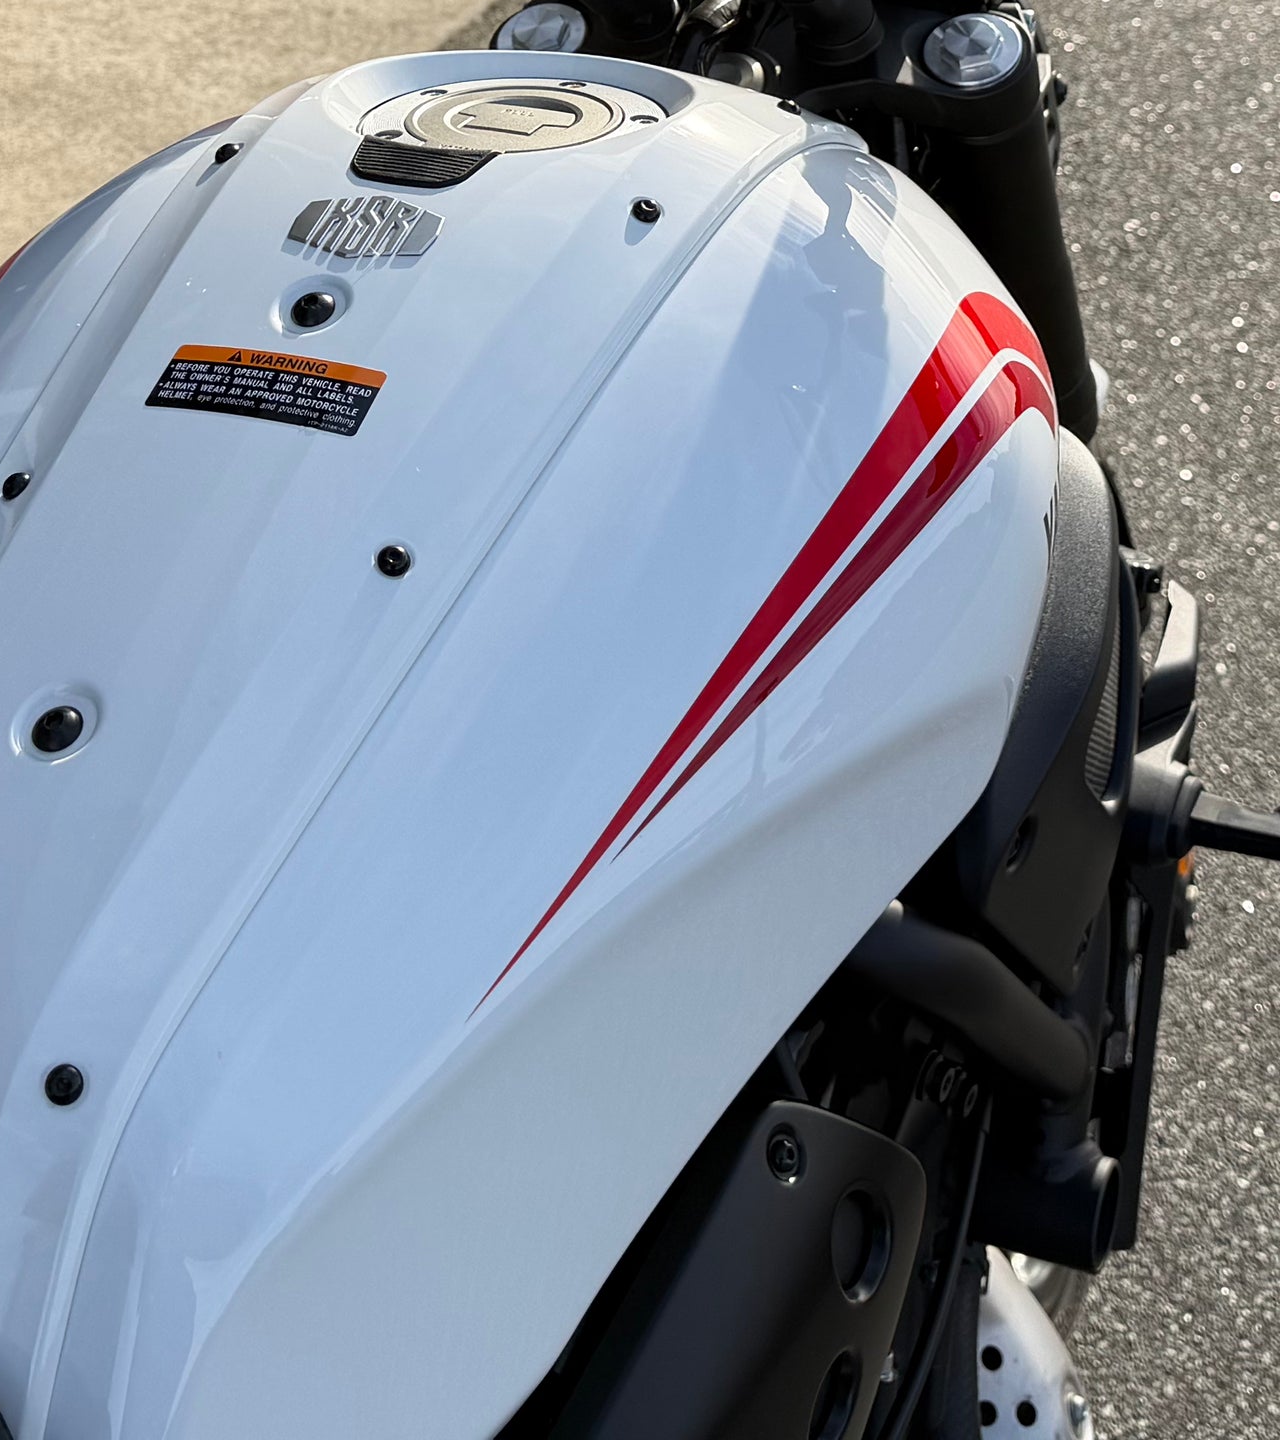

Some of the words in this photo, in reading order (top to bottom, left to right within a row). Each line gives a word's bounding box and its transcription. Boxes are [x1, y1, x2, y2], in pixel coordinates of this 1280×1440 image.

[310, 195, 421, 258] XSR
[175, 362, 210, 373] BEFORE
[213, 365, 230, 375] YOU
[234, 367, 274, 380] OPERATE
[278, 373, 298, 384] THIS
[346, 384, 372, 398] READ
[249, 352, 329, 375] WARNING
[163, 380, 197, 392] ALWAYS
[200, 383, 226, 395] WEAR
[229, 386, 241, 396] AN
[244, 389, 293, 404] APPROVED
[296, 397, 359, 418] MOTORCYCLE
[170, 371, 187, 380] THE
[190, 373, 230, 384] OWNER'S
[233, 377, 269, 389] MANUAL
[273, 382, 292, 392] AND
[295, 386, 313, 395] ALL
[317, 389, 354, 404] LABELS.
[158, 390, 193, 401] HELMET,
[197, 394, 212, 403] eye
[214, 394, 255, 409] protection,
[259, 401, 276, 411] and
[278, 403, 319, 420] protective
[322, 411, 356, 428] clothing.
